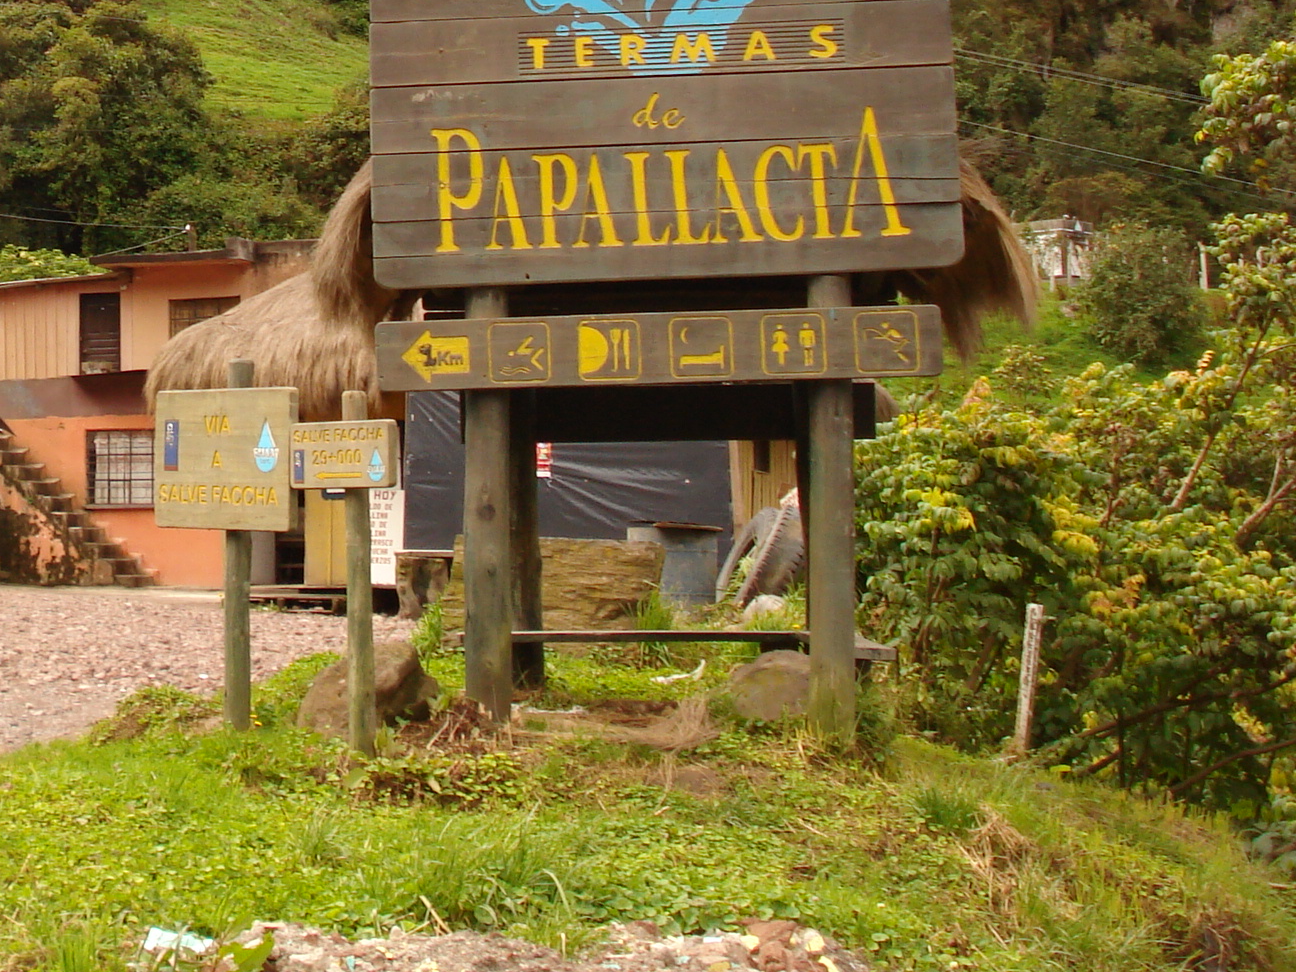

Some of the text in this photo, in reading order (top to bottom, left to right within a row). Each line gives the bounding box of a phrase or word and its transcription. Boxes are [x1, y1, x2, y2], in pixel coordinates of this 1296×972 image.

[526, 24, 838, 69] TERMAS
[632, 91, 686, 129] de
[431, 106, 911, 254] PAPALLACTA
[204, 415, 230, 434] VIA
[293, 427, 383, 443] SALVE FACCHA
[211, 450, 222, 468] A
[159, 483, 279, 506] SALVE FACCHA
[374, 490, 397, 500] HOY
